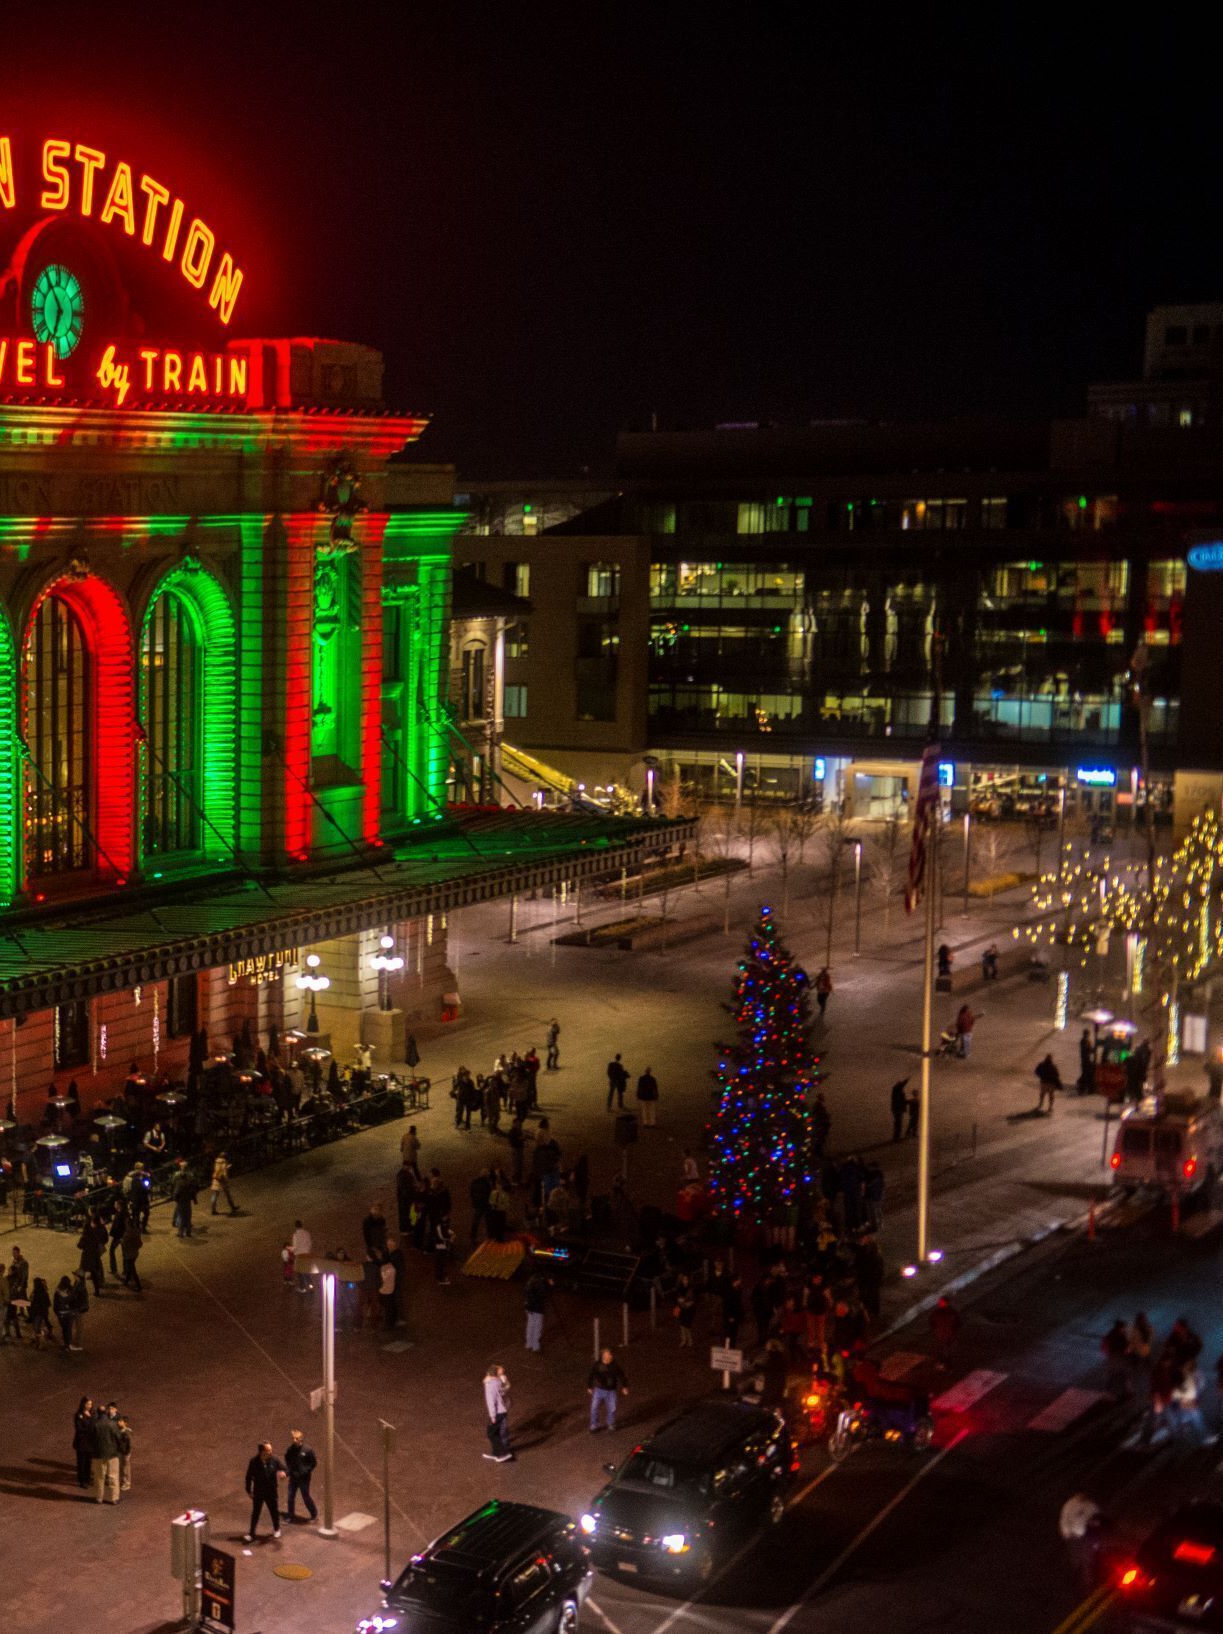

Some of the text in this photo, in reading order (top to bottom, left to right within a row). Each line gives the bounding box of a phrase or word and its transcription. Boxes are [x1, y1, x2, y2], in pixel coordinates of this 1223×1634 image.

[40, 138, 244, 326] STATION
[96, 344, 131, 406] by
[140, 351, 248, 395] TRAIN
